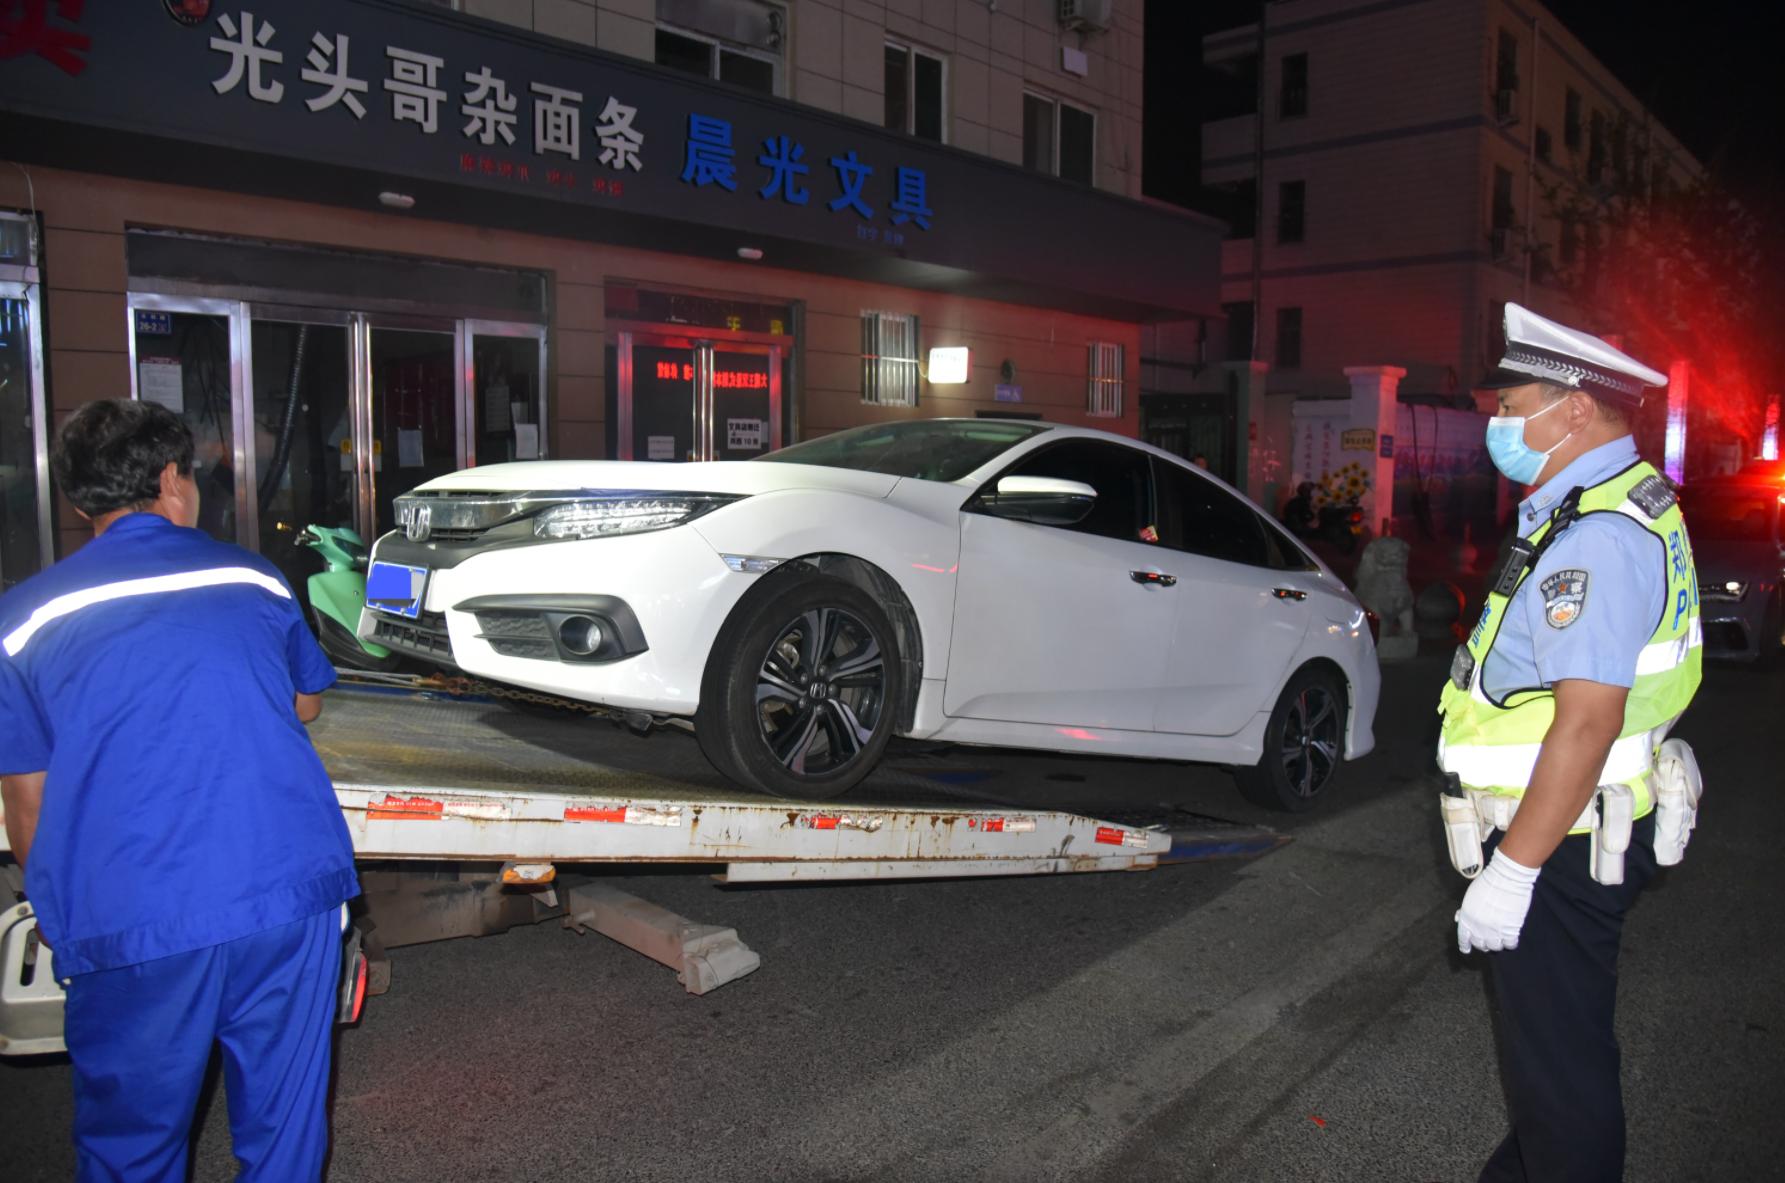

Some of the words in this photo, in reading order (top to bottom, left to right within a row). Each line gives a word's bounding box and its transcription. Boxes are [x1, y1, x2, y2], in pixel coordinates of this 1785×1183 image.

[210, 11, 645, 172] 光头哥杂面条
[682, 113, 934, 230] 晨光文具
